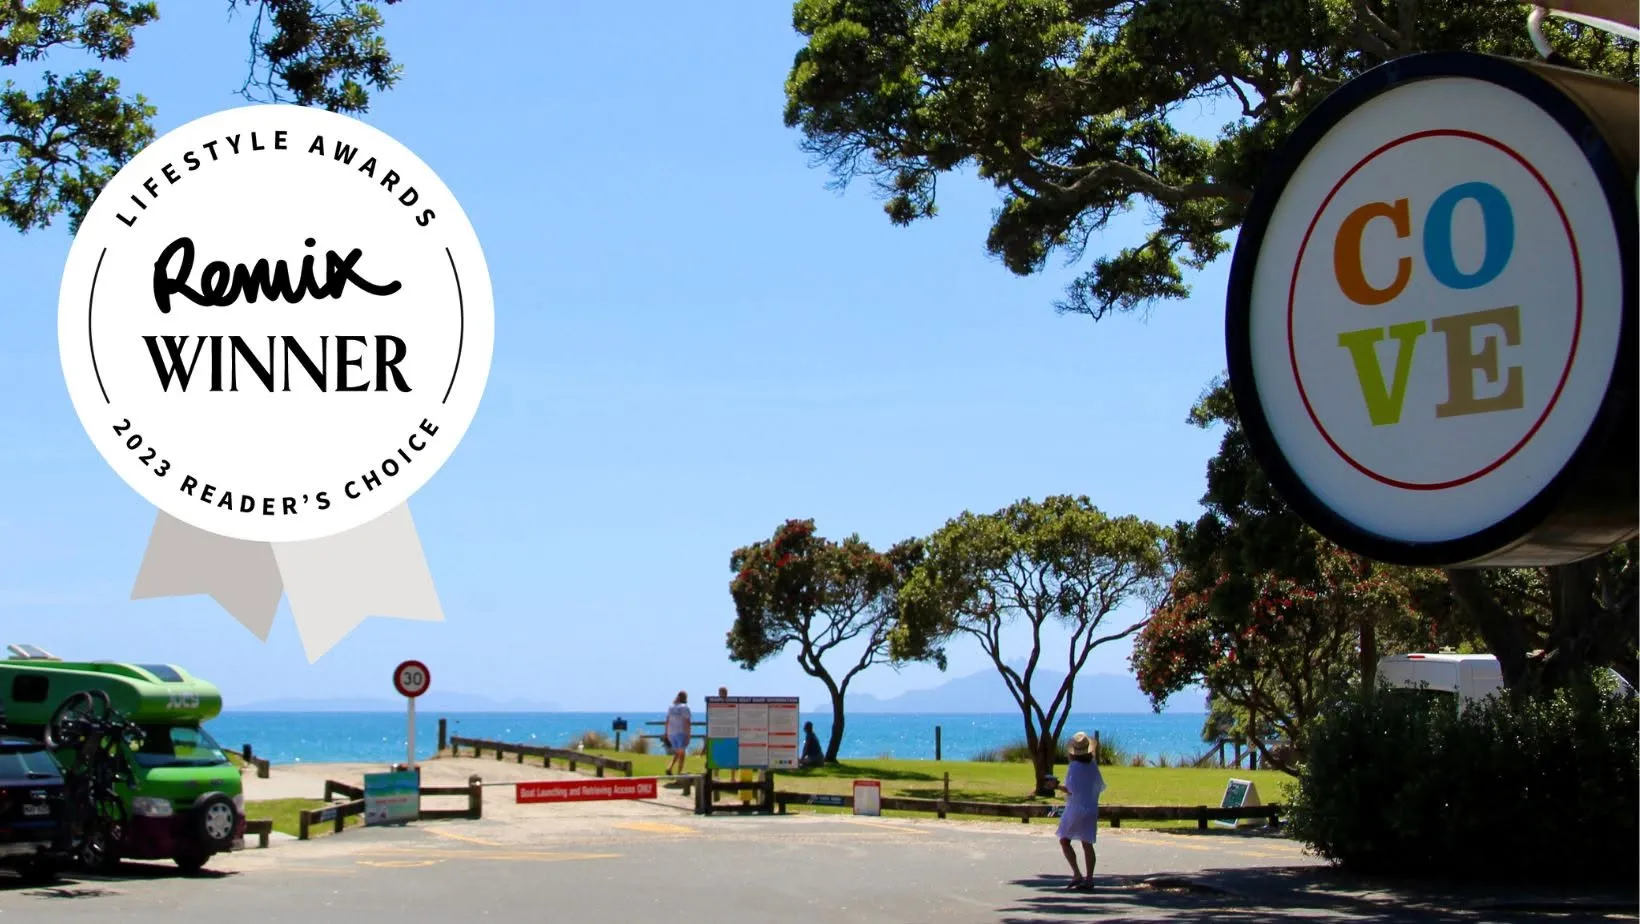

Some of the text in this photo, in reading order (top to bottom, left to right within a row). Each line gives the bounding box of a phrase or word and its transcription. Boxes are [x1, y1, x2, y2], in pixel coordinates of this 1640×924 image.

[403, 671, 423, 686] 30
[520, 787, 535, 798] Boat
[569, 786, 580, 797] and
[614, 784, 636, 794] Access
